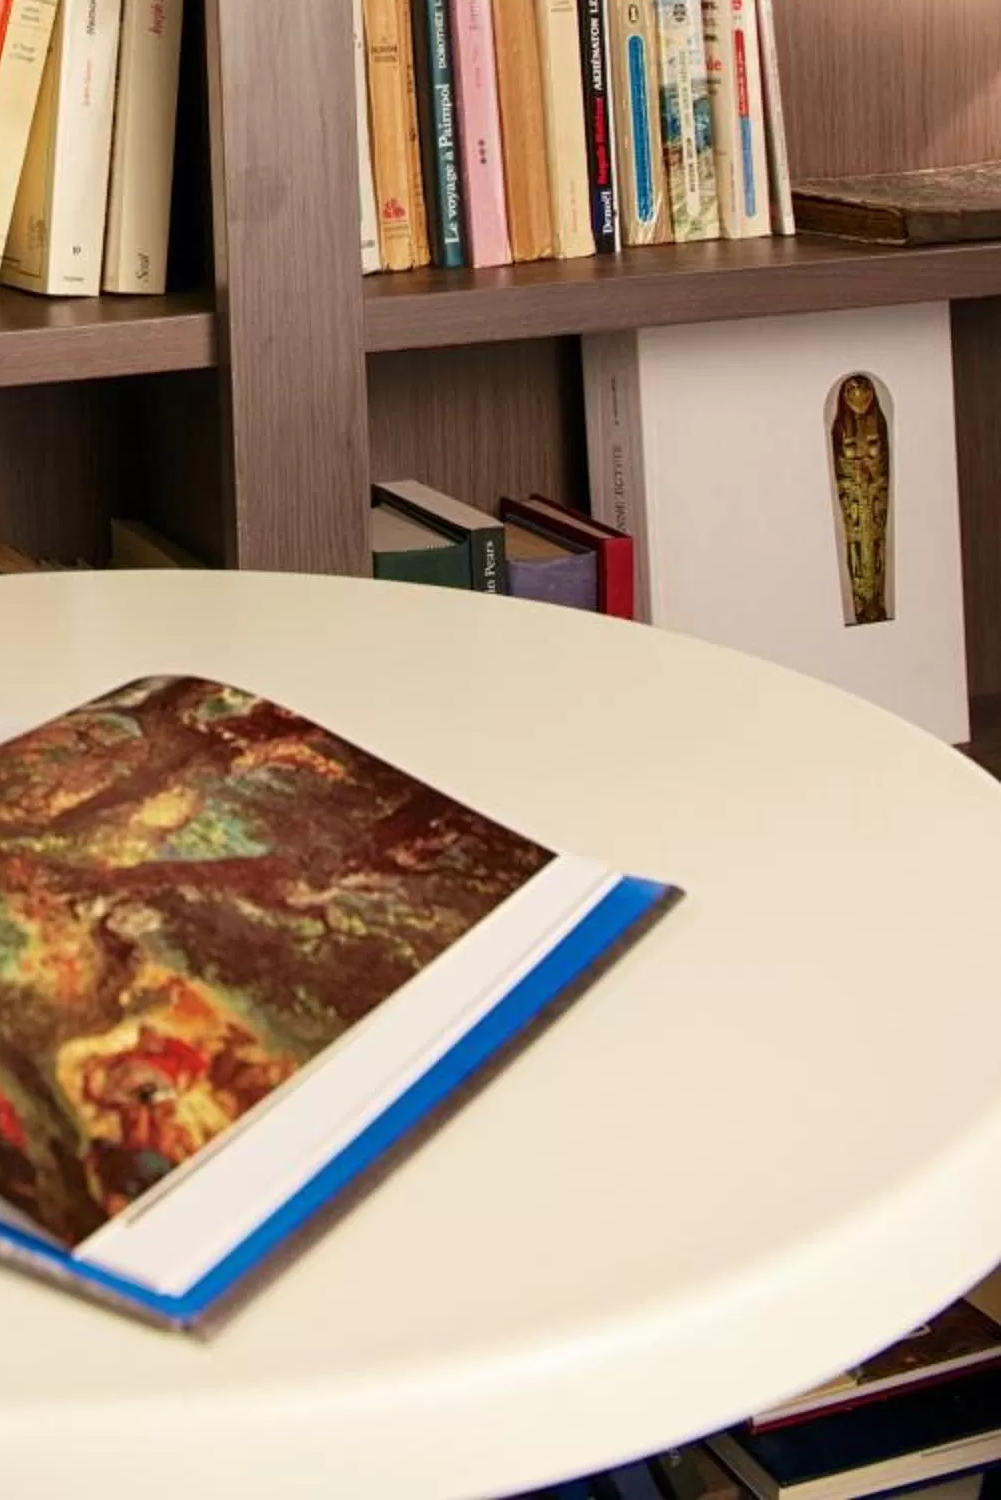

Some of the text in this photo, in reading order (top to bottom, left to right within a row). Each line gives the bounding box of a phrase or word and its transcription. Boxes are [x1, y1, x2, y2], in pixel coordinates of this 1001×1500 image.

[435, 82, 460, 245] Le voyage à Paimpol
[599, 190, 613, 236] Denoël
[484, 540, 496, 577] Pears
